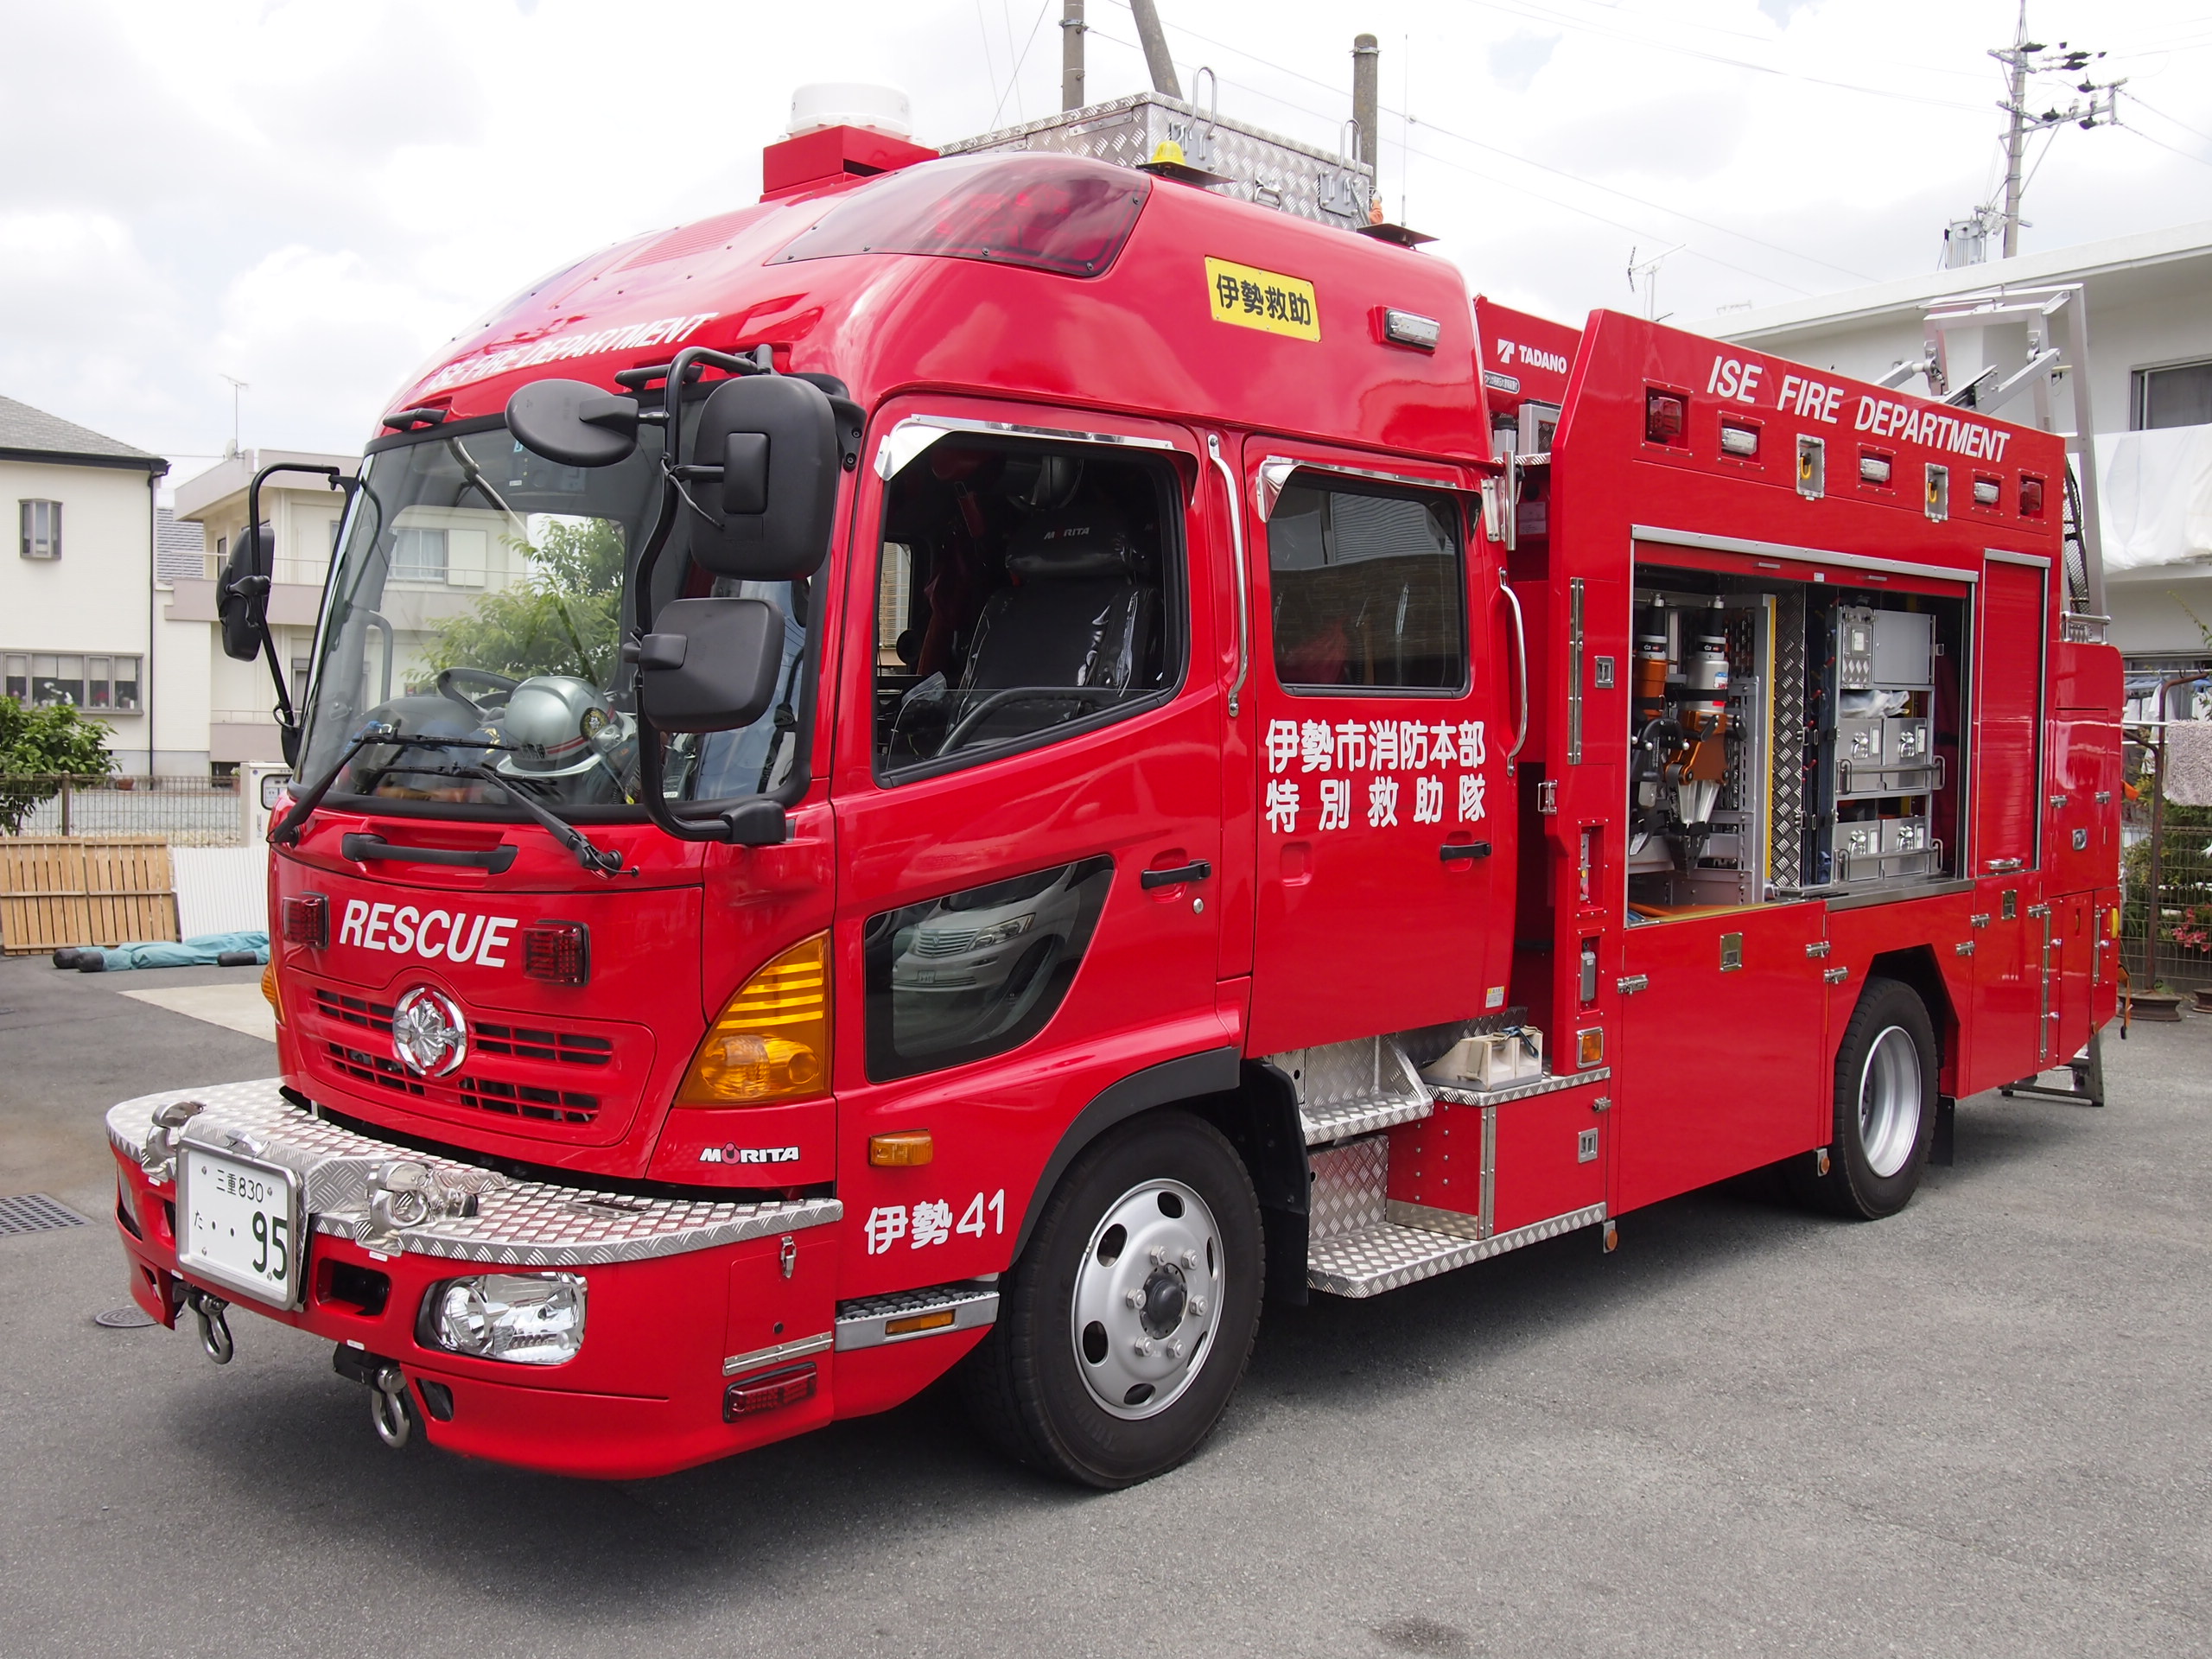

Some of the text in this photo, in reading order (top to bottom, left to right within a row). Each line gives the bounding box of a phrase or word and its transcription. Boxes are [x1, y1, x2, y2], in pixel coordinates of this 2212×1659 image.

[1217, 273, 1311, 326] 伊勢救助
[459, 346, 531, 382] FIRE
[514, 312, 719, 368] DEPARTMENT
[1519, 344, 1567, 374] TADANO
[1707, 355, 2010, 462] ISE FIRE DEPARTMENT
[1265, 718, 1486, 773] 伊勢市消防本部
[339, 899, 518, 968] RESCUE
[699, 1141, 799, 1165] MORITA
